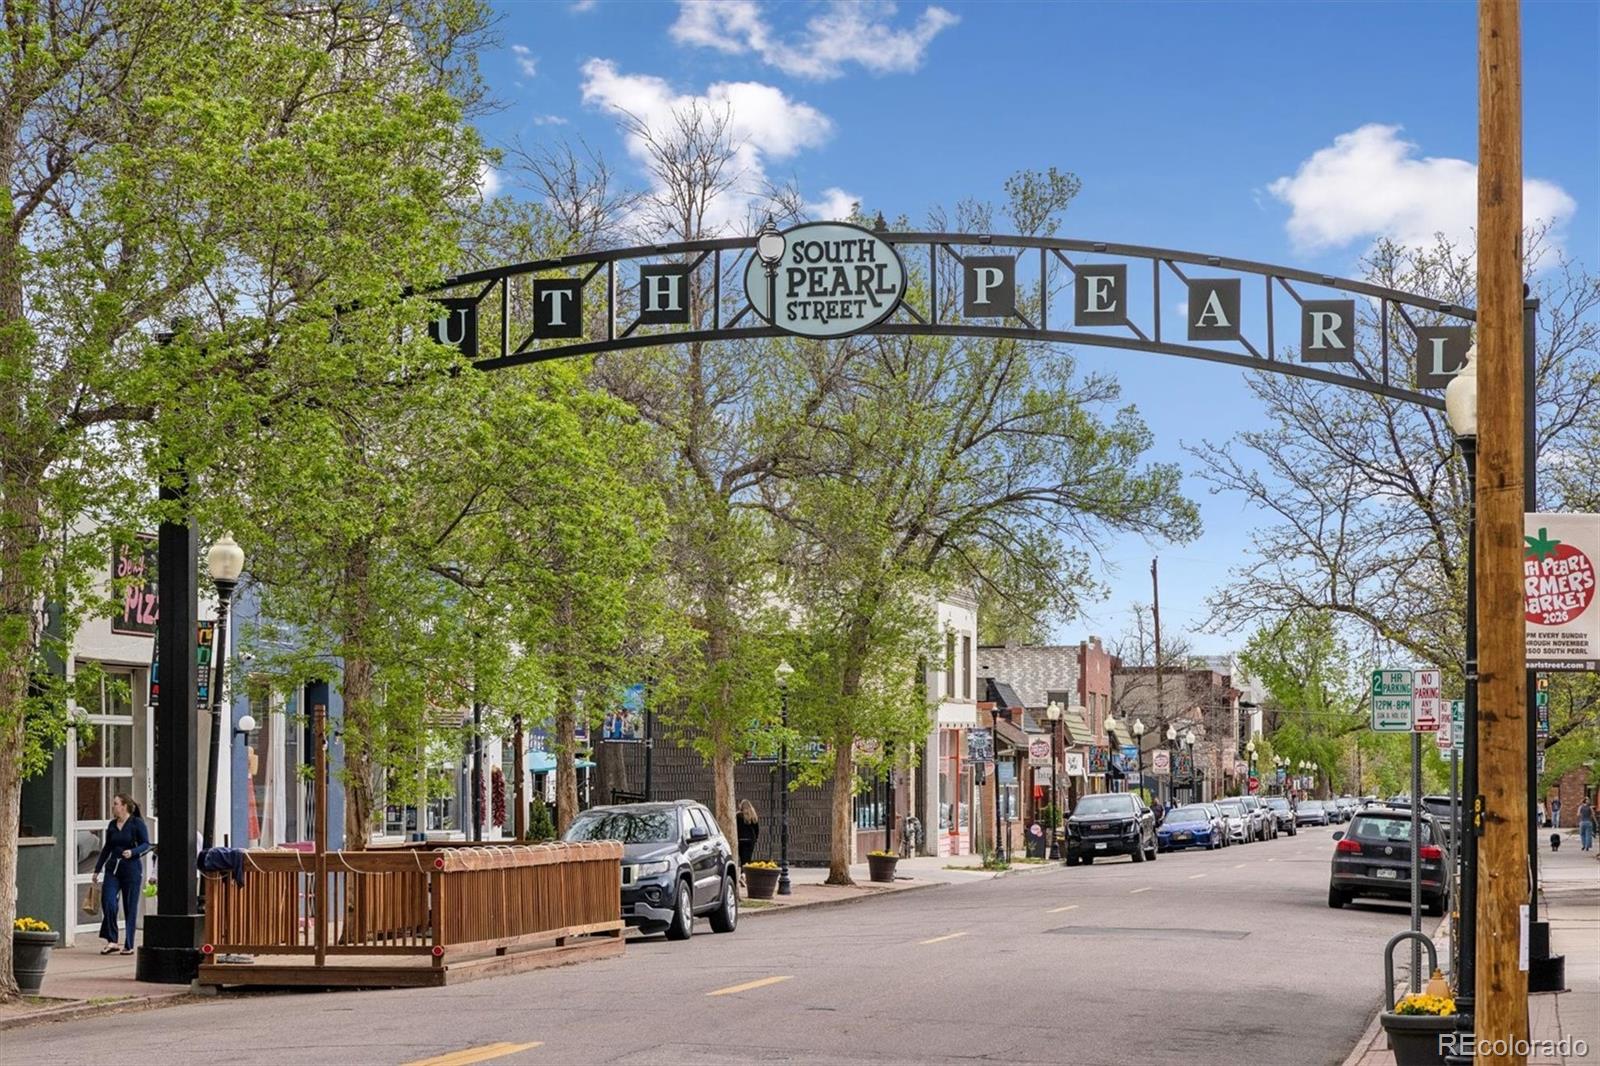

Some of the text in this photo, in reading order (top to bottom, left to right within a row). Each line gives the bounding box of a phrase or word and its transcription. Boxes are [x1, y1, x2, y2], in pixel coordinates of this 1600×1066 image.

[792, 238, 876, 264] SOUTH
[786, 263, 897, 308] PEARL
[786, 299, 868, 324] STREET
[972, 266, 1463, 376] PEARL
[1524, 570, 1594, 597] RMERS
[1524, 591, 1587, 614] aRKET
[1525, 661, 1585, 669] earlstreet.com
[1373, 675, 1382, 693] 2
[1383, 683, 1411, 693] PARKING
[1390, 673, 1403, 683] HR
[1421, 673, 1432, 685] NO
[1415, 687, 1439, 699] PARKING
